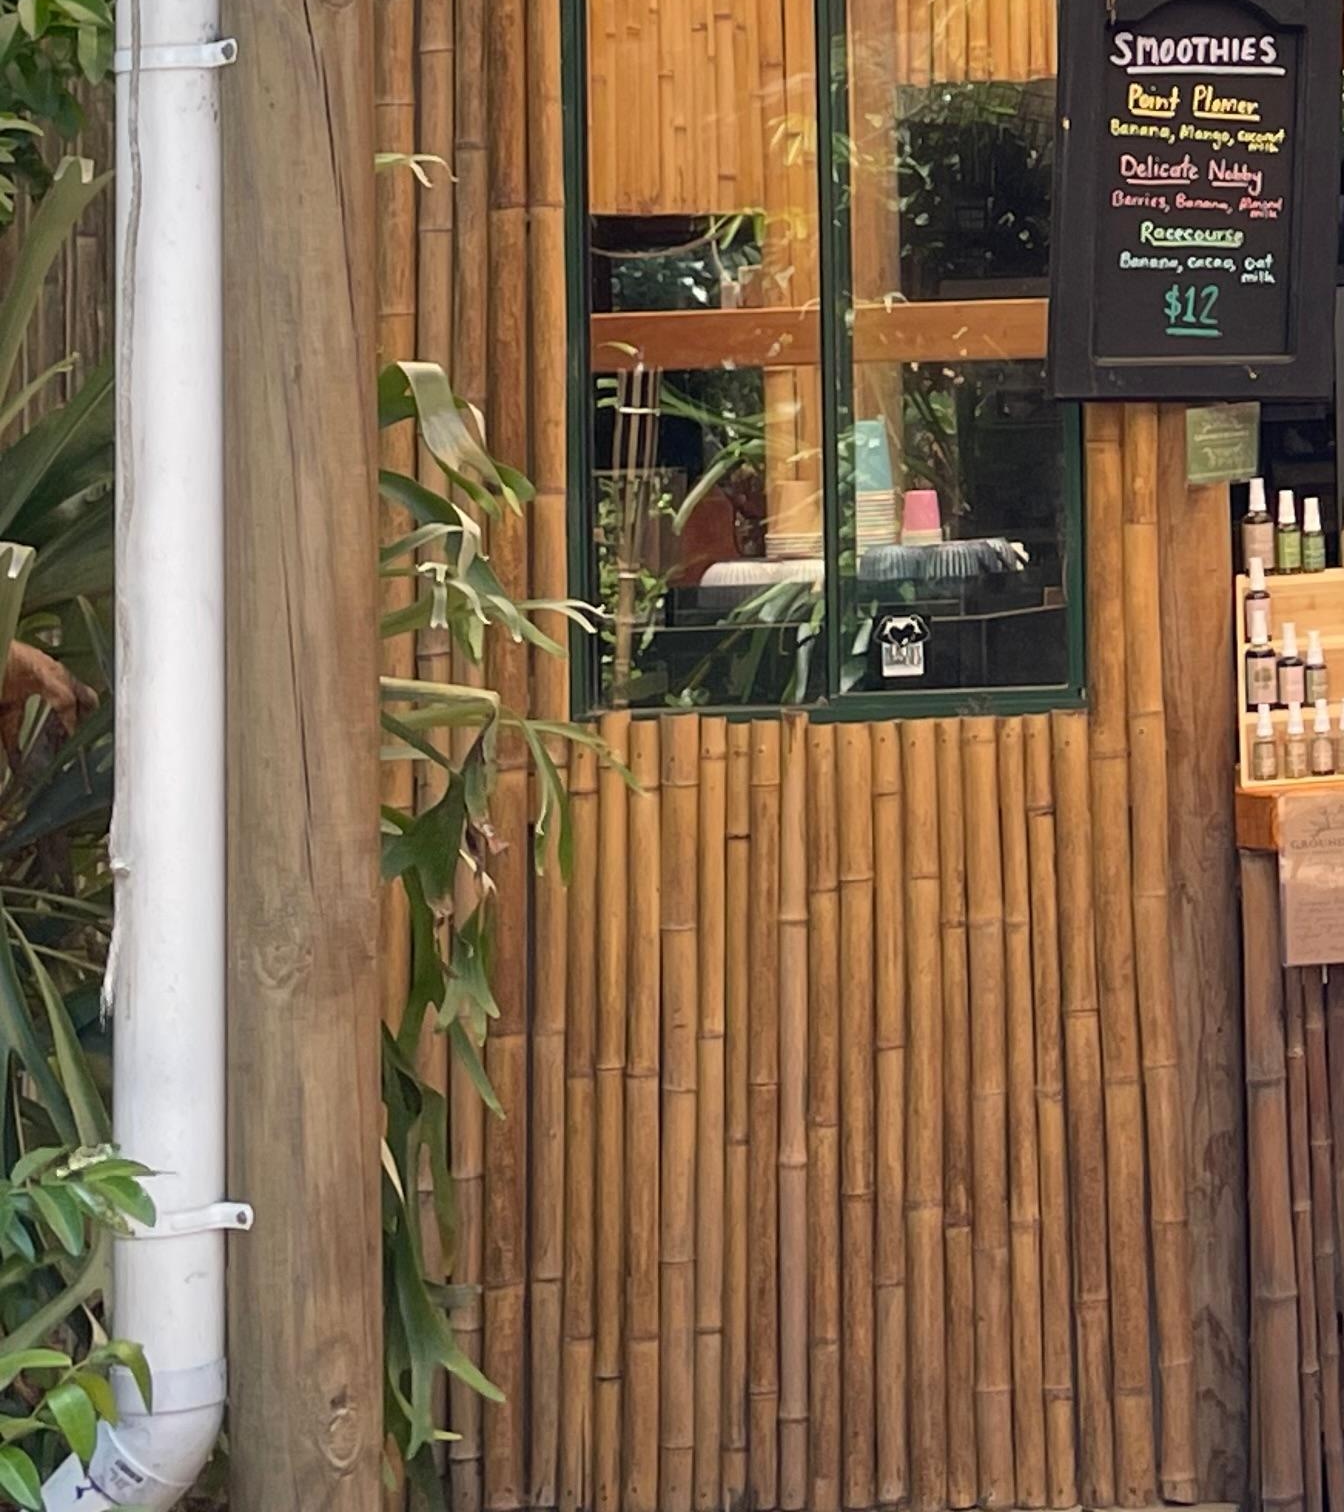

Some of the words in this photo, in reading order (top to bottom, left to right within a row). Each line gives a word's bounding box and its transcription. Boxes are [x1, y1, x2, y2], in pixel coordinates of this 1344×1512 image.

[1109, 31, 1278, 66] SMOOTHIES
[1128, 82, 1180, 111] Point
[1192, 84, 1259, 115] Plomer
[1110, 118, 1175, 144] Banana,
[1179, 123, 1235, 150] Mango,
[1120, 153, 1200, 180] Delicate
[1111, 189, 1170, 213] Berries,
[1175, 191, 1234, 215] Banana,
[1140, 220, 1245, 244] Racecourse
[1119, 250, 1184, 274] Banana,
[1187, 255, 1237, 273] cacao,
[1240, 270, 1276, 284] milk
[1163, 284, 1220, 325] $12
